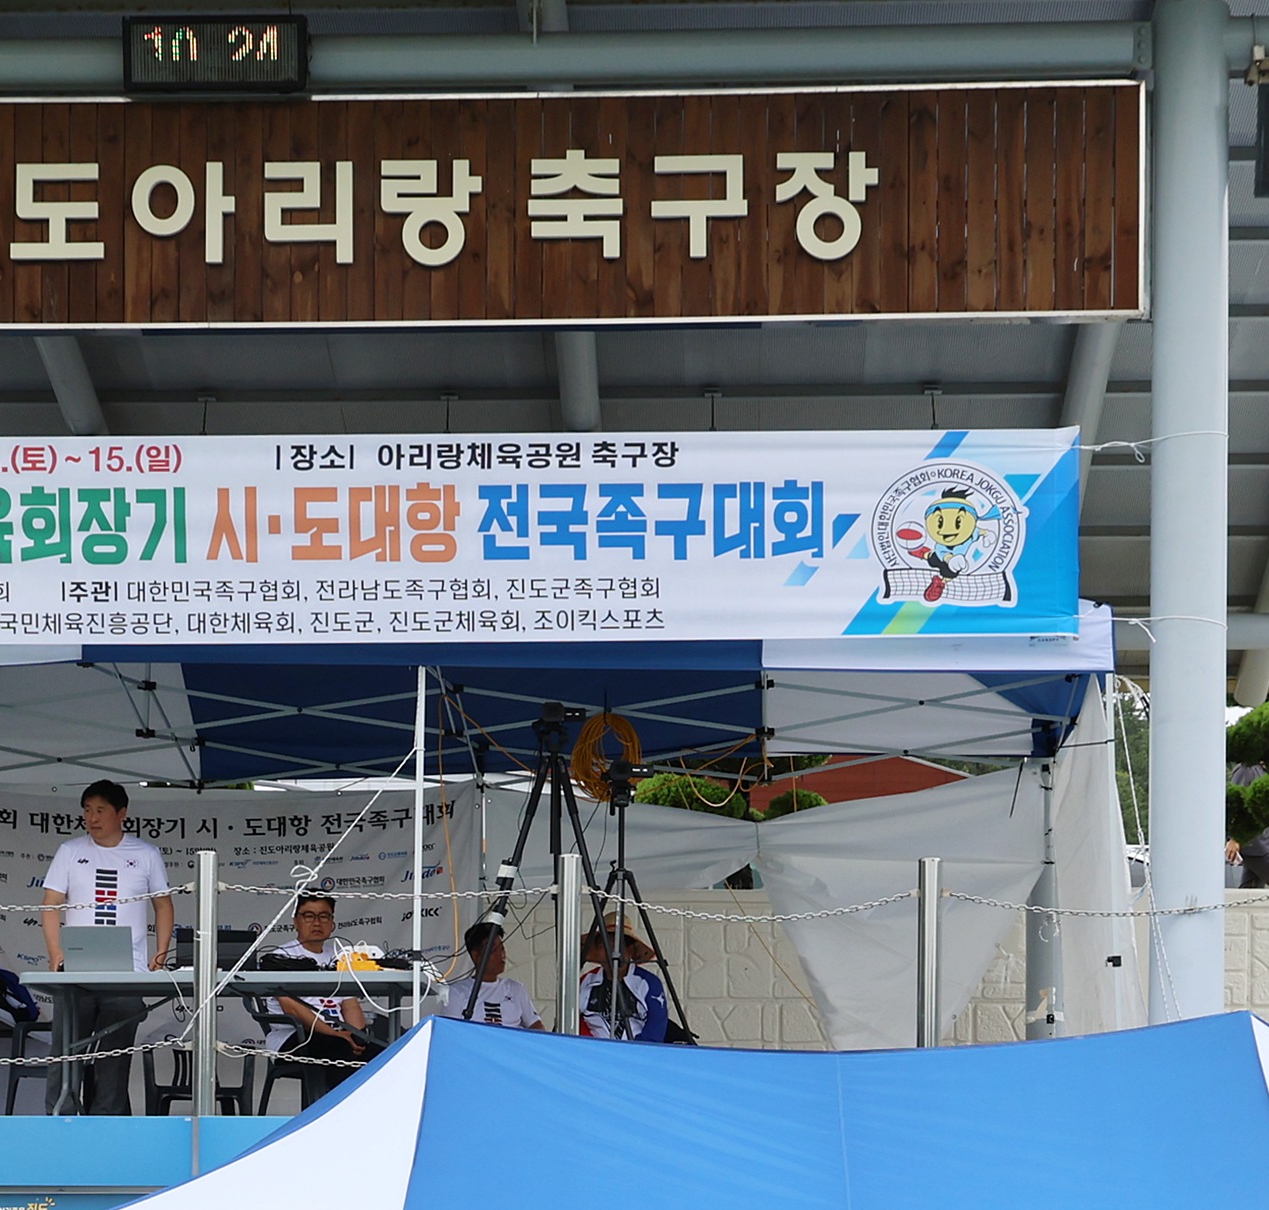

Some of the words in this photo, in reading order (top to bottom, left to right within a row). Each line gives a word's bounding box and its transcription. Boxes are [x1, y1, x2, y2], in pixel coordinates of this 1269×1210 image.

[527, 149, 879, 262] 축구장
[377, 441, 582, 471] 아리랑체육공원
[591, 441, 680, 468] 축구장
[937, 468, 975, 484] KOREA
[974, 477, 1006, 505] JOKGU
[206, 482, 461, 564] 시·도대항
[476, 479, 824, 561] 전국족구대회
[987, 505, 1016, 572] ASSOCIATION
[127, 580, 309, 604] 대한민국족구협회,
[315, 579, 499, 604] 전라남도족구협회,
[506, 577, 661, 601] 진도군족구협회
[187, 610, 303, 636] 대한체육회,
[309, 611, 382, 636] 진도군,
[388, 609, 528, 634] 진도군체육회,
[533, 608, 665, 632] 조이킥스포츠
